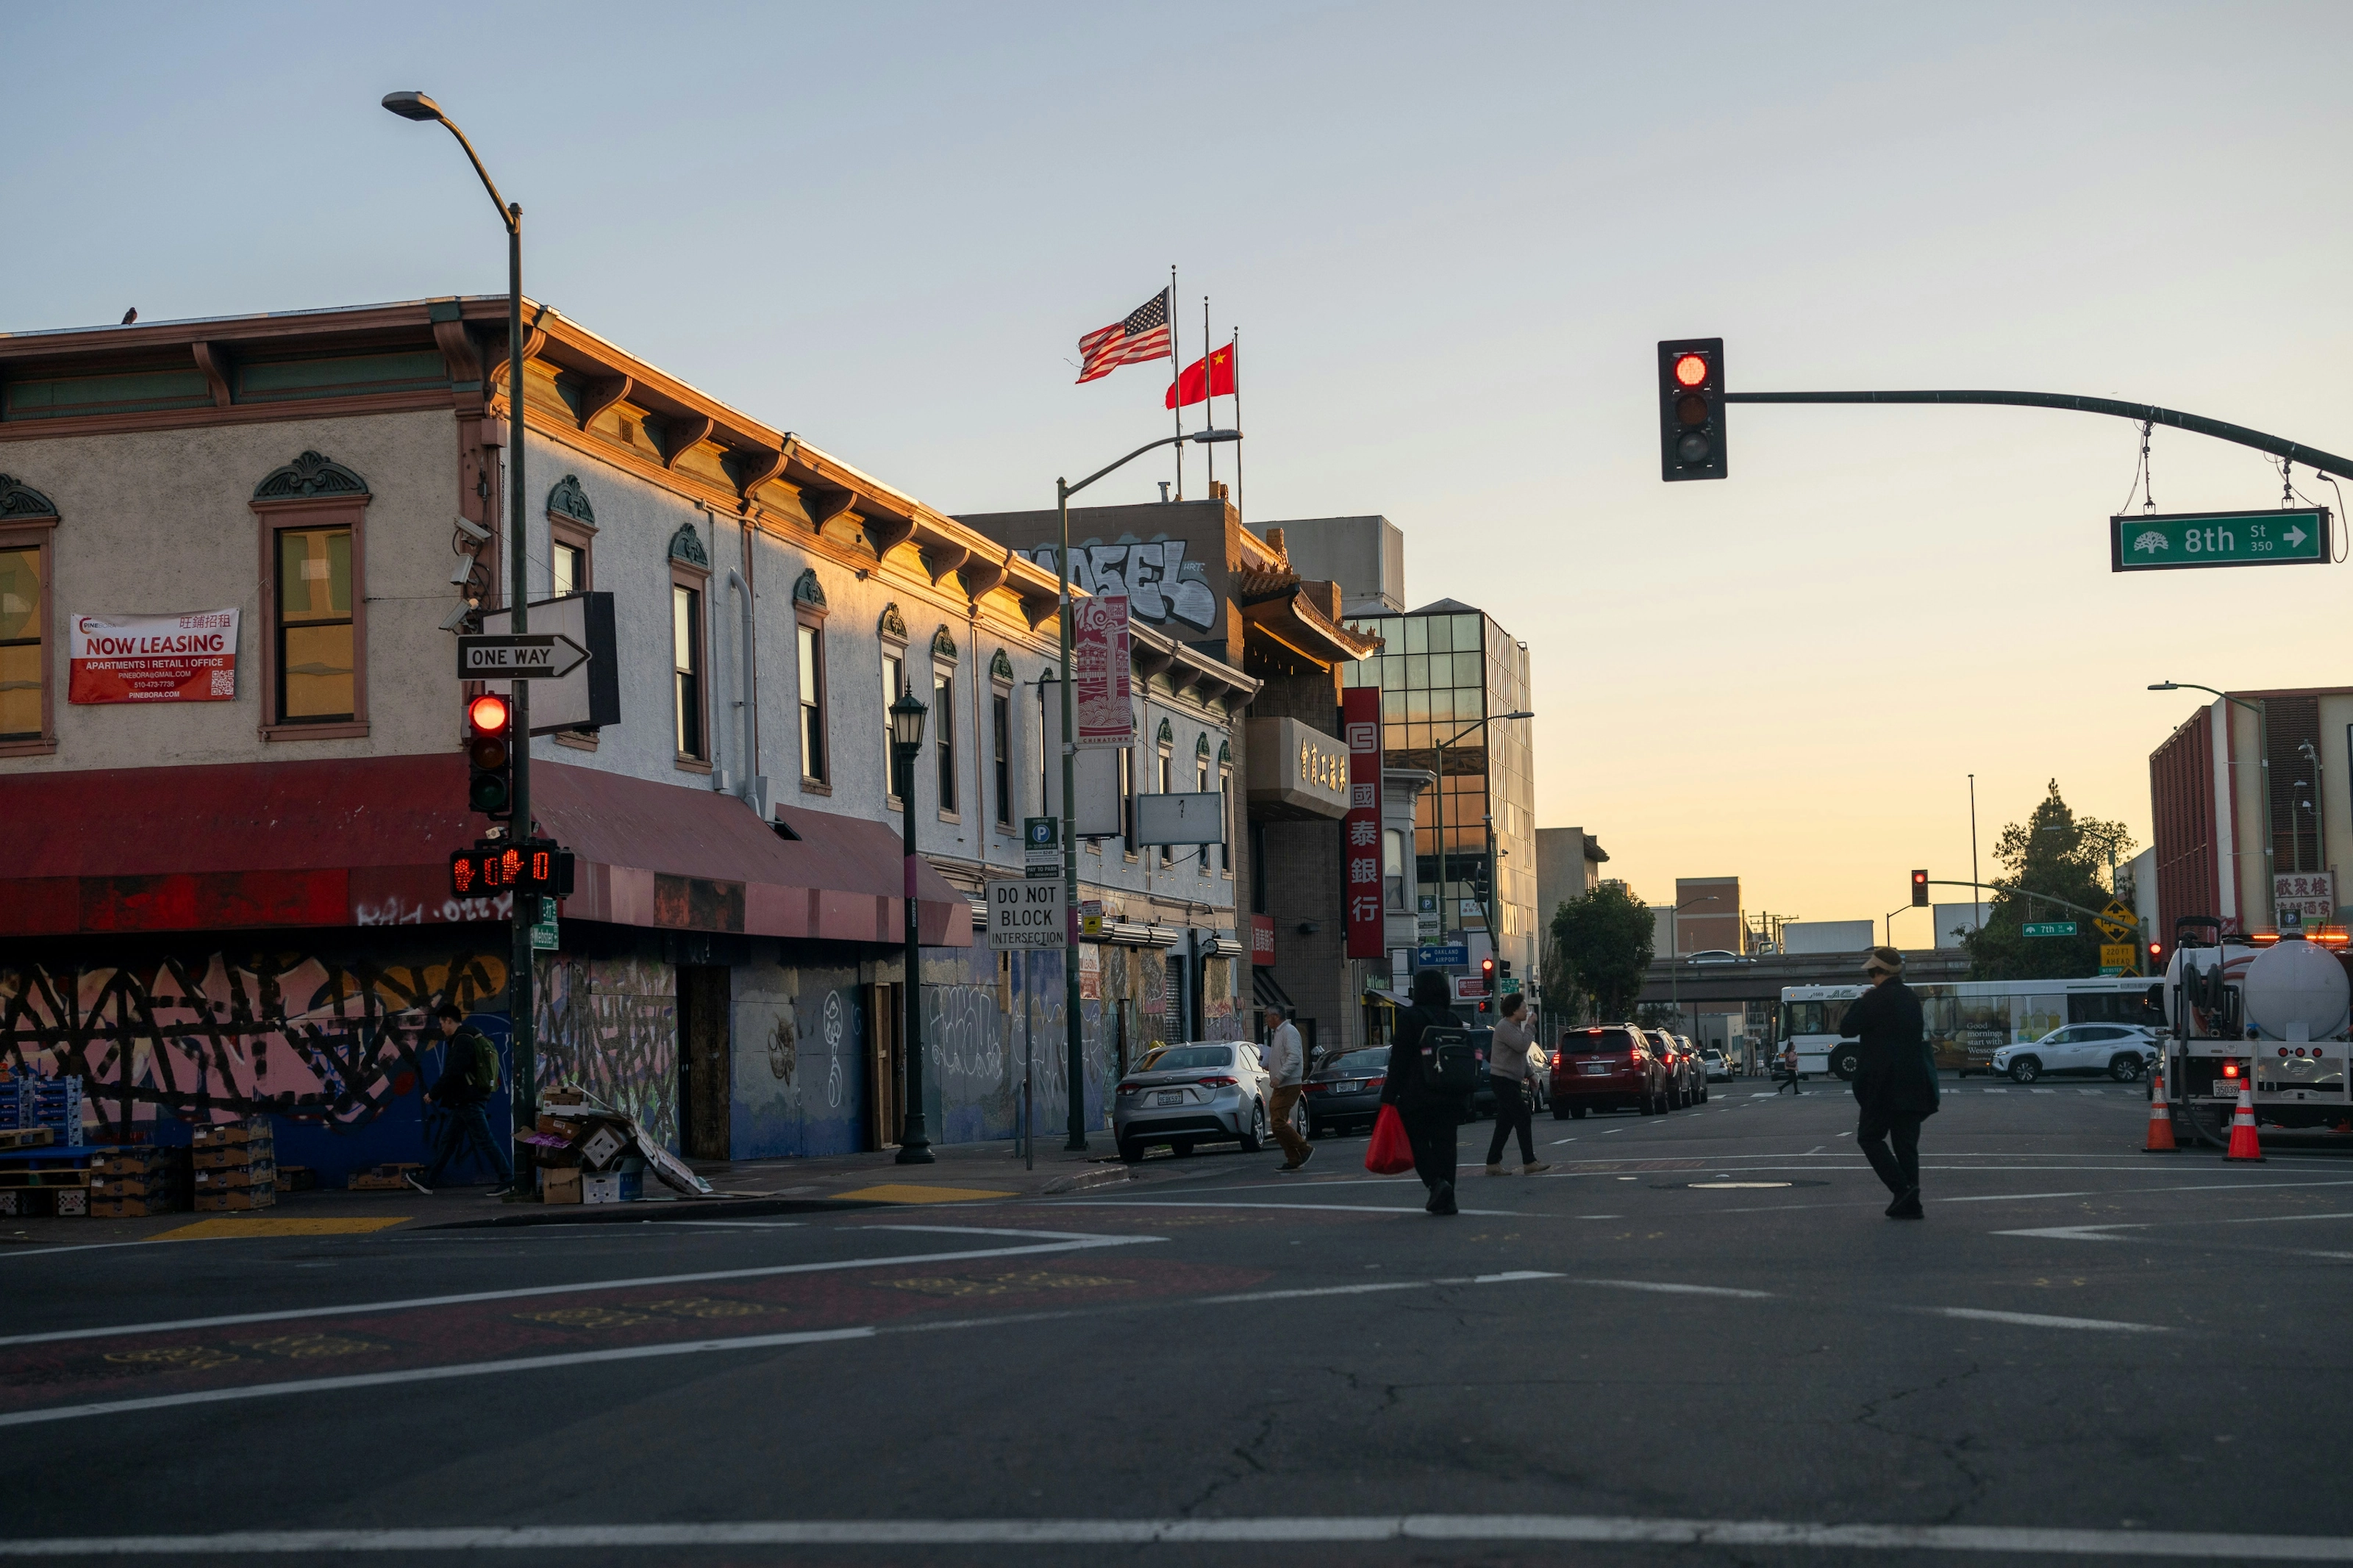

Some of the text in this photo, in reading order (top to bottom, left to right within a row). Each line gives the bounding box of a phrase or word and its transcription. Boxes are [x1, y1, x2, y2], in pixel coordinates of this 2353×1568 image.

[2185, 525, 2266, 553] 8th St
[2251, 541, 2273, 551] 350
[179, 614, 231, 629] 旺鋪招租
[86, 634, 224, 655] NOW LEASING
[85, 658, 223, 670] APARTMENTS RETAIL OFFICE
[472, 648, 551, 665] ONE WAY
[118, 671, 191, 679] PINEBORA@GMAIL.COM
[1351, 783, 1379, 922] 國泰銀行
[998, 887, 1056, 903] DO NOT
[2276, 876, 2328, 897] 歡聚樓
[1001, 909, 1052, 926] BLOCK
[534, 928, 553, 945] Webster
[993, 931, 1063, 944] INTERSECTION
[1254, 928, 1274, 953] 國泰銀行
[1967, 1030, 2003, 1038] mornings
